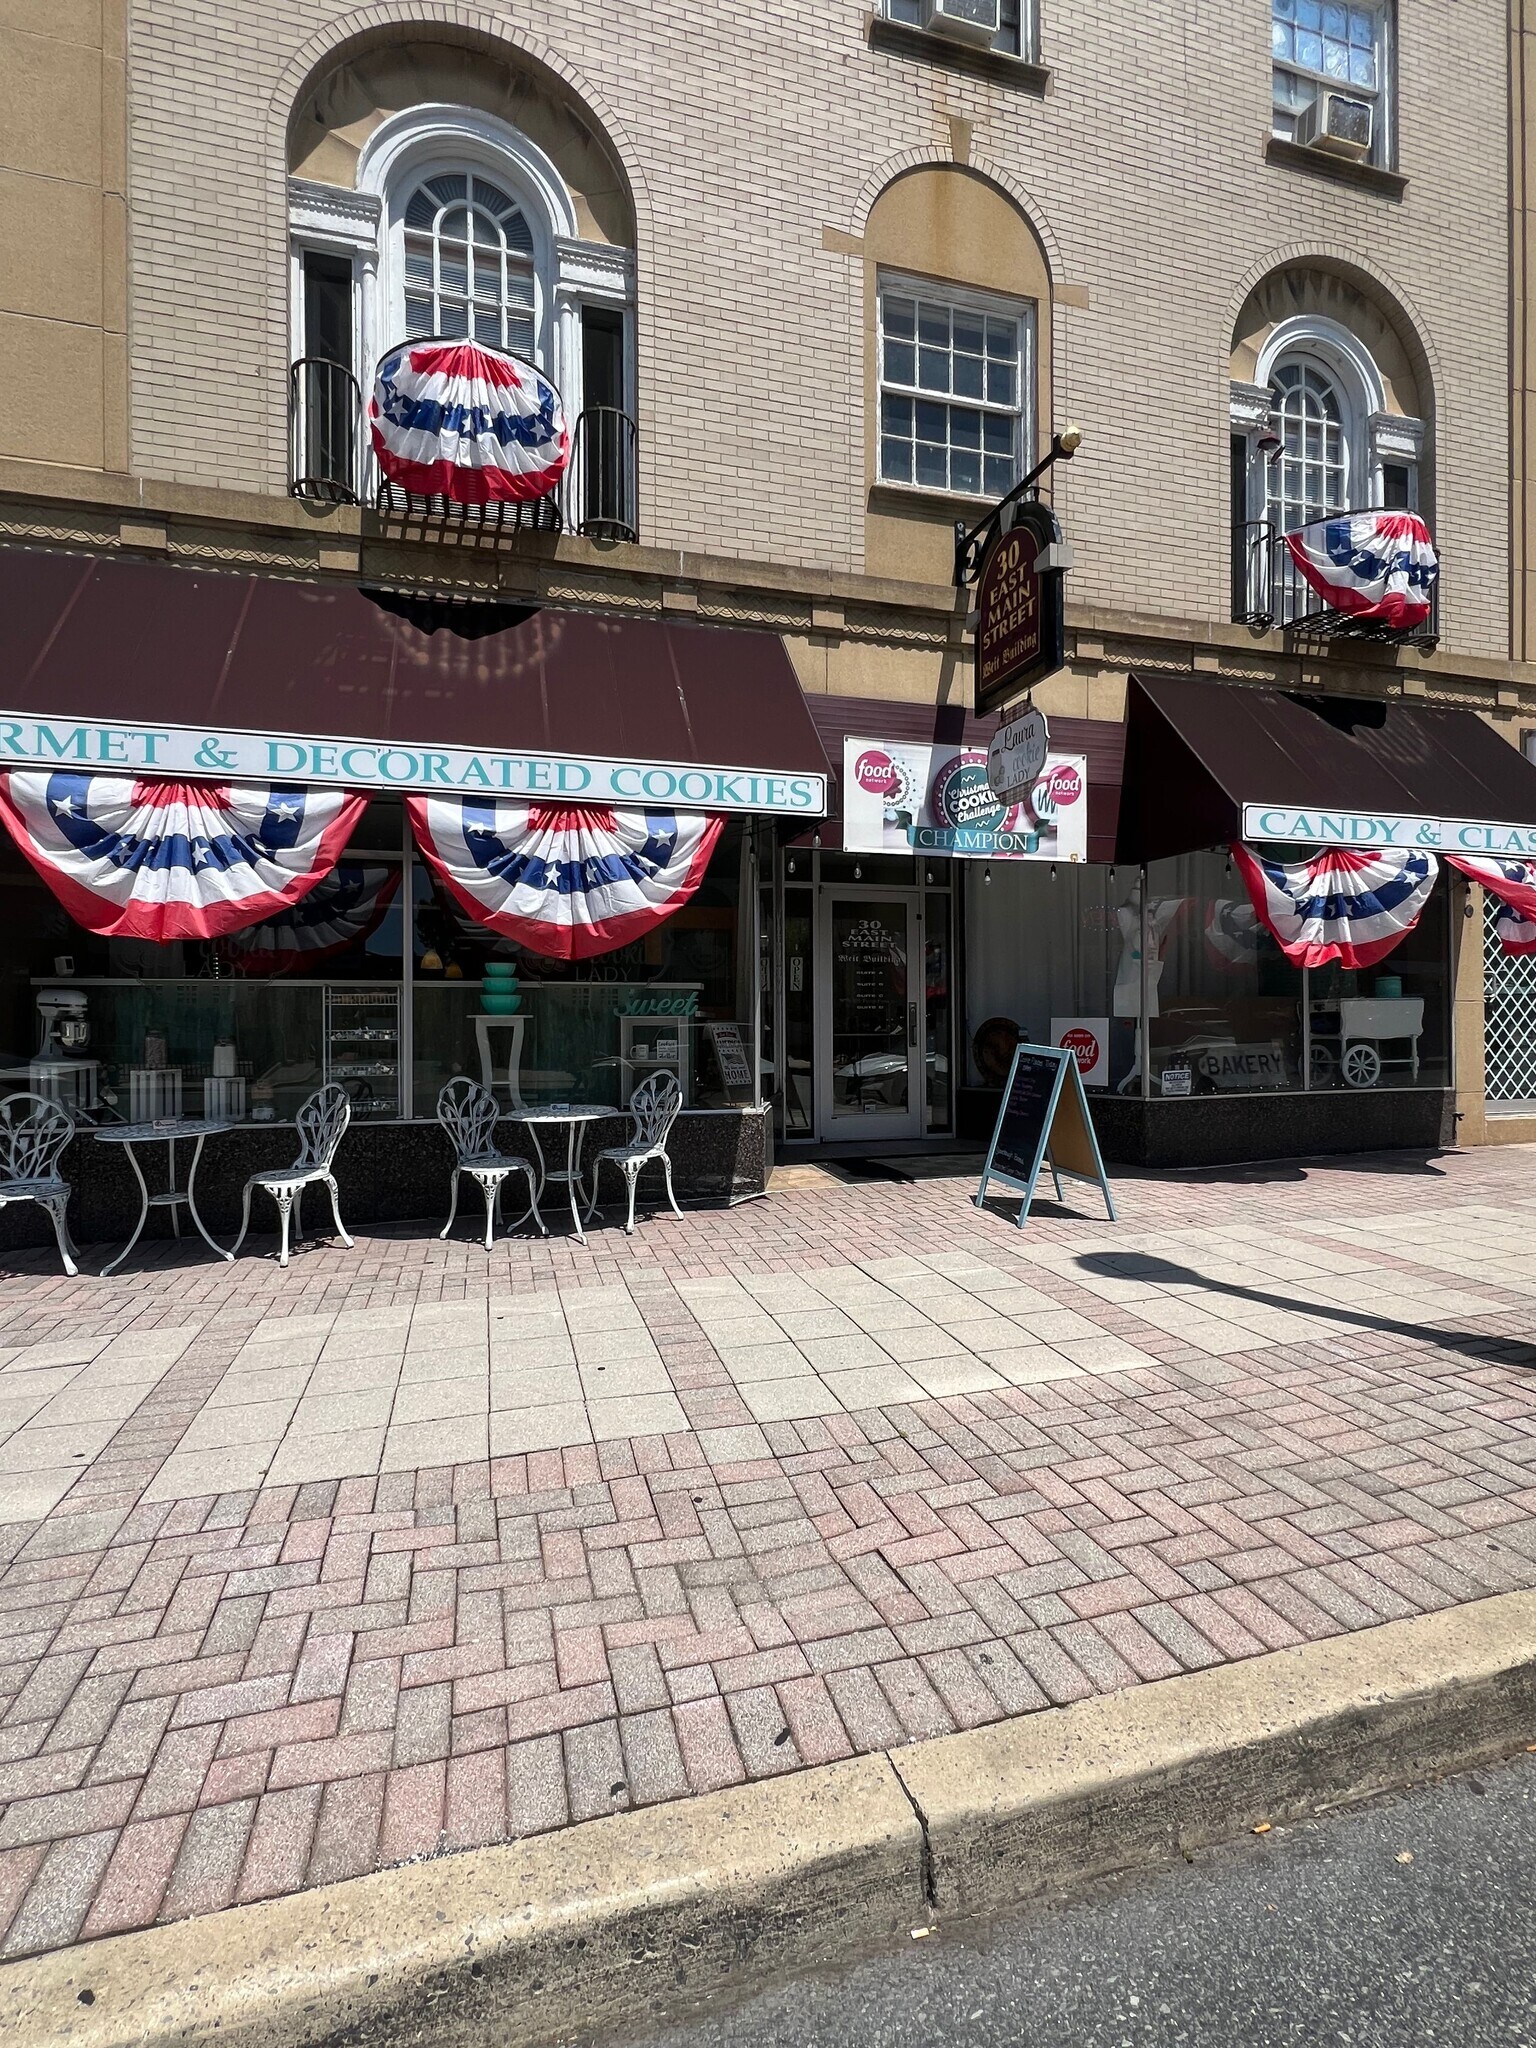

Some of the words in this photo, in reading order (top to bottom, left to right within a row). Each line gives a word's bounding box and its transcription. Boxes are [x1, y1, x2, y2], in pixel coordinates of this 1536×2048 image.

[997, 539, 1020, 580] 30
[990, 561, 1027, 606] EAST
[988, 580, 1031, 629] MAIN
[983, 597, 1036, 650] STREET
[1002, 632, 1037, 665] Building
[1001, 723, 1035, 753] Laura
[0, 722, 169, 764] RMET
[193, 737, 239, 769] &
[265, 741, 592, 792] DECORATED
[610, 767, 813, 807] COOKIES
[856, 759, 894, 783] food
[1007, 767, 1030, 787] LADY
[1048, 773, 1080, 796] food
[948, 782, 990, 800] Christma
[955, 803, 1001, 823] Challenge
[919, 829, 1029, 851] CHAMPION
[1259, 811, 1401, 843] CANDY
[1416, 823, 1441, 846] &
[858, 920, 882, 930] 30
[576, 966, 632, 982] LADY
[793, 958, 801, 990] OPEN
[724, 1070, 749, 1080] HOME
[1207, 1054, 1280, 1074] BAKERY
[1165, 1072, 1190, 1080] NOTICE
